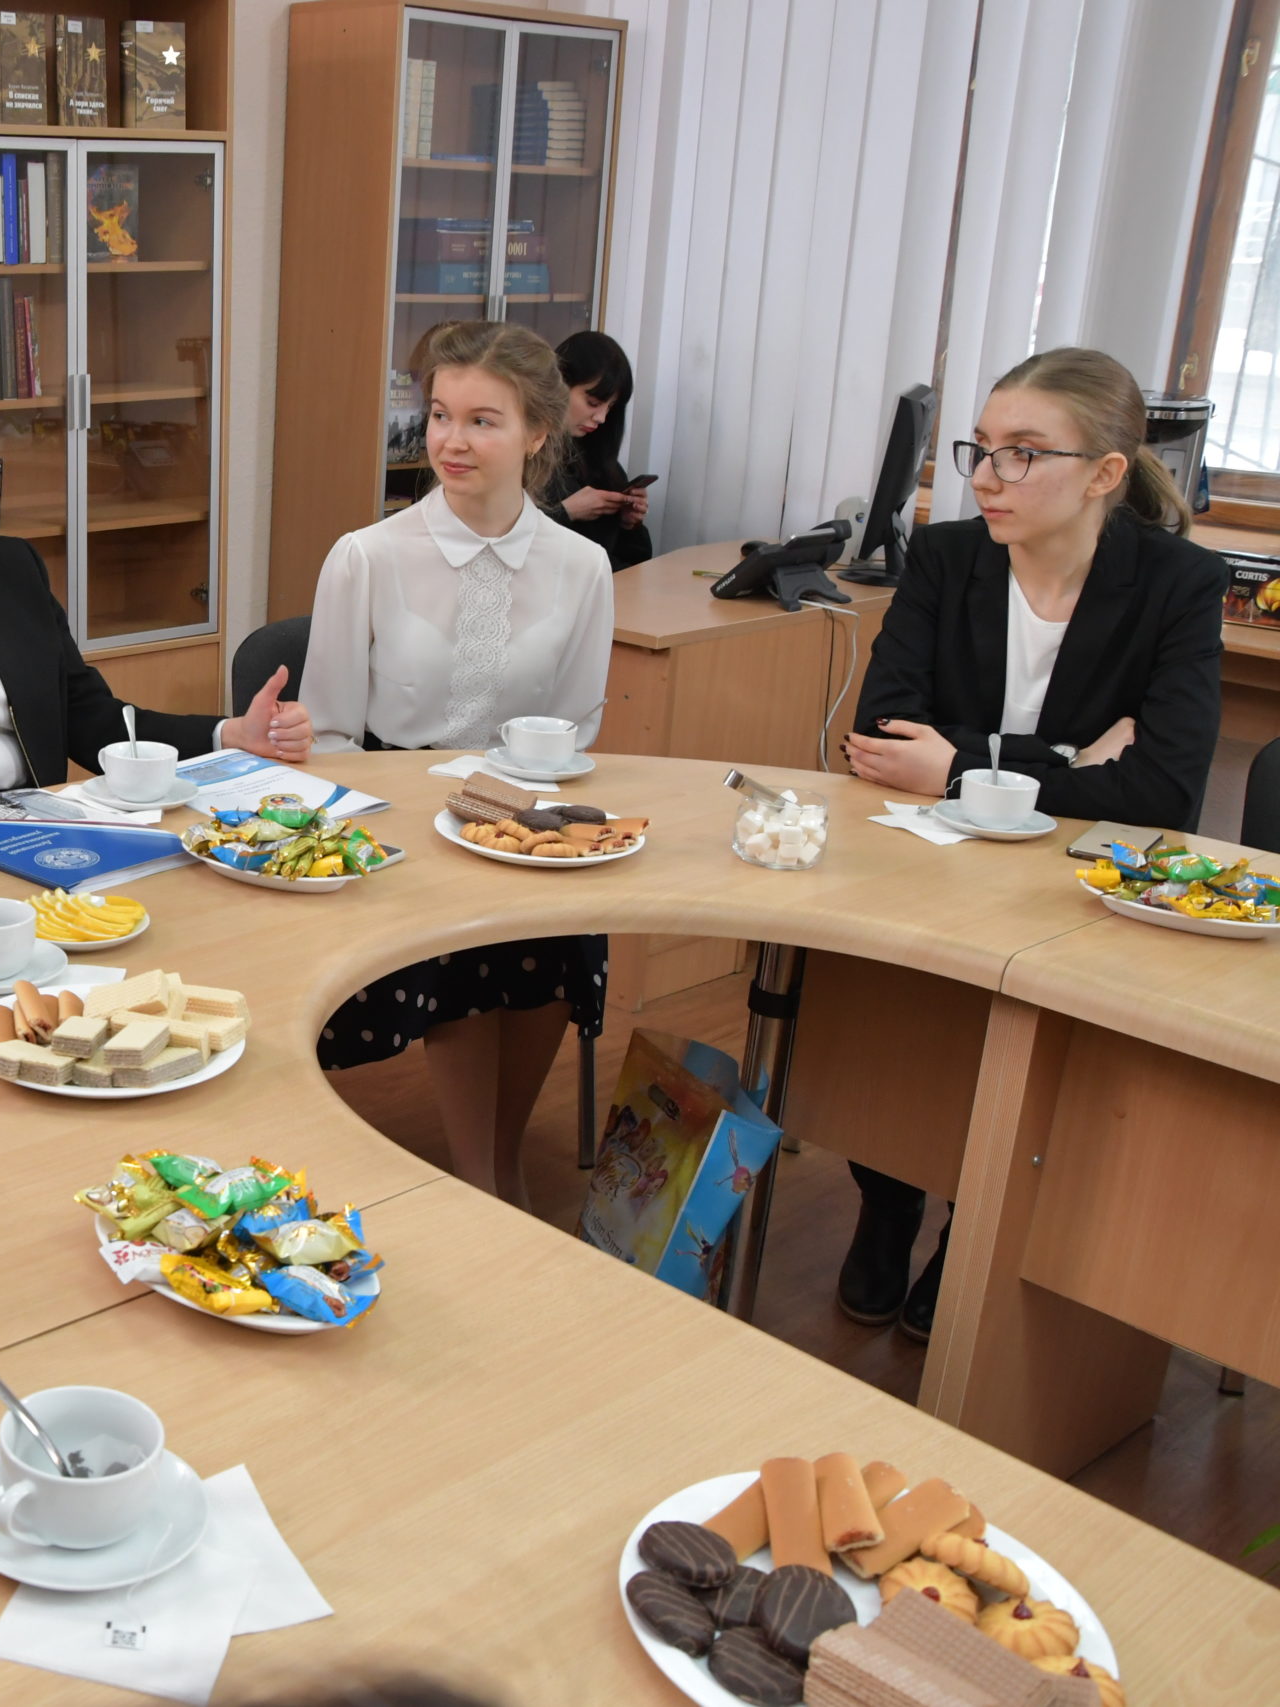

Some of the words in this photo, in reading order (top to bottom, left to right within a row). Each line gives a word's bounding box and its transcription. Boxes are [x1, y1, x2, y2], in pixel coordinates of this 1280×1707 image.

[8, 91, 14, 99] В
[14, 92, 39, 100] списках
[75, 100, 89, 108] зори
[146, 96, 175, 105] Горячий
[1235, 570, 1269, 582] CURTIS
